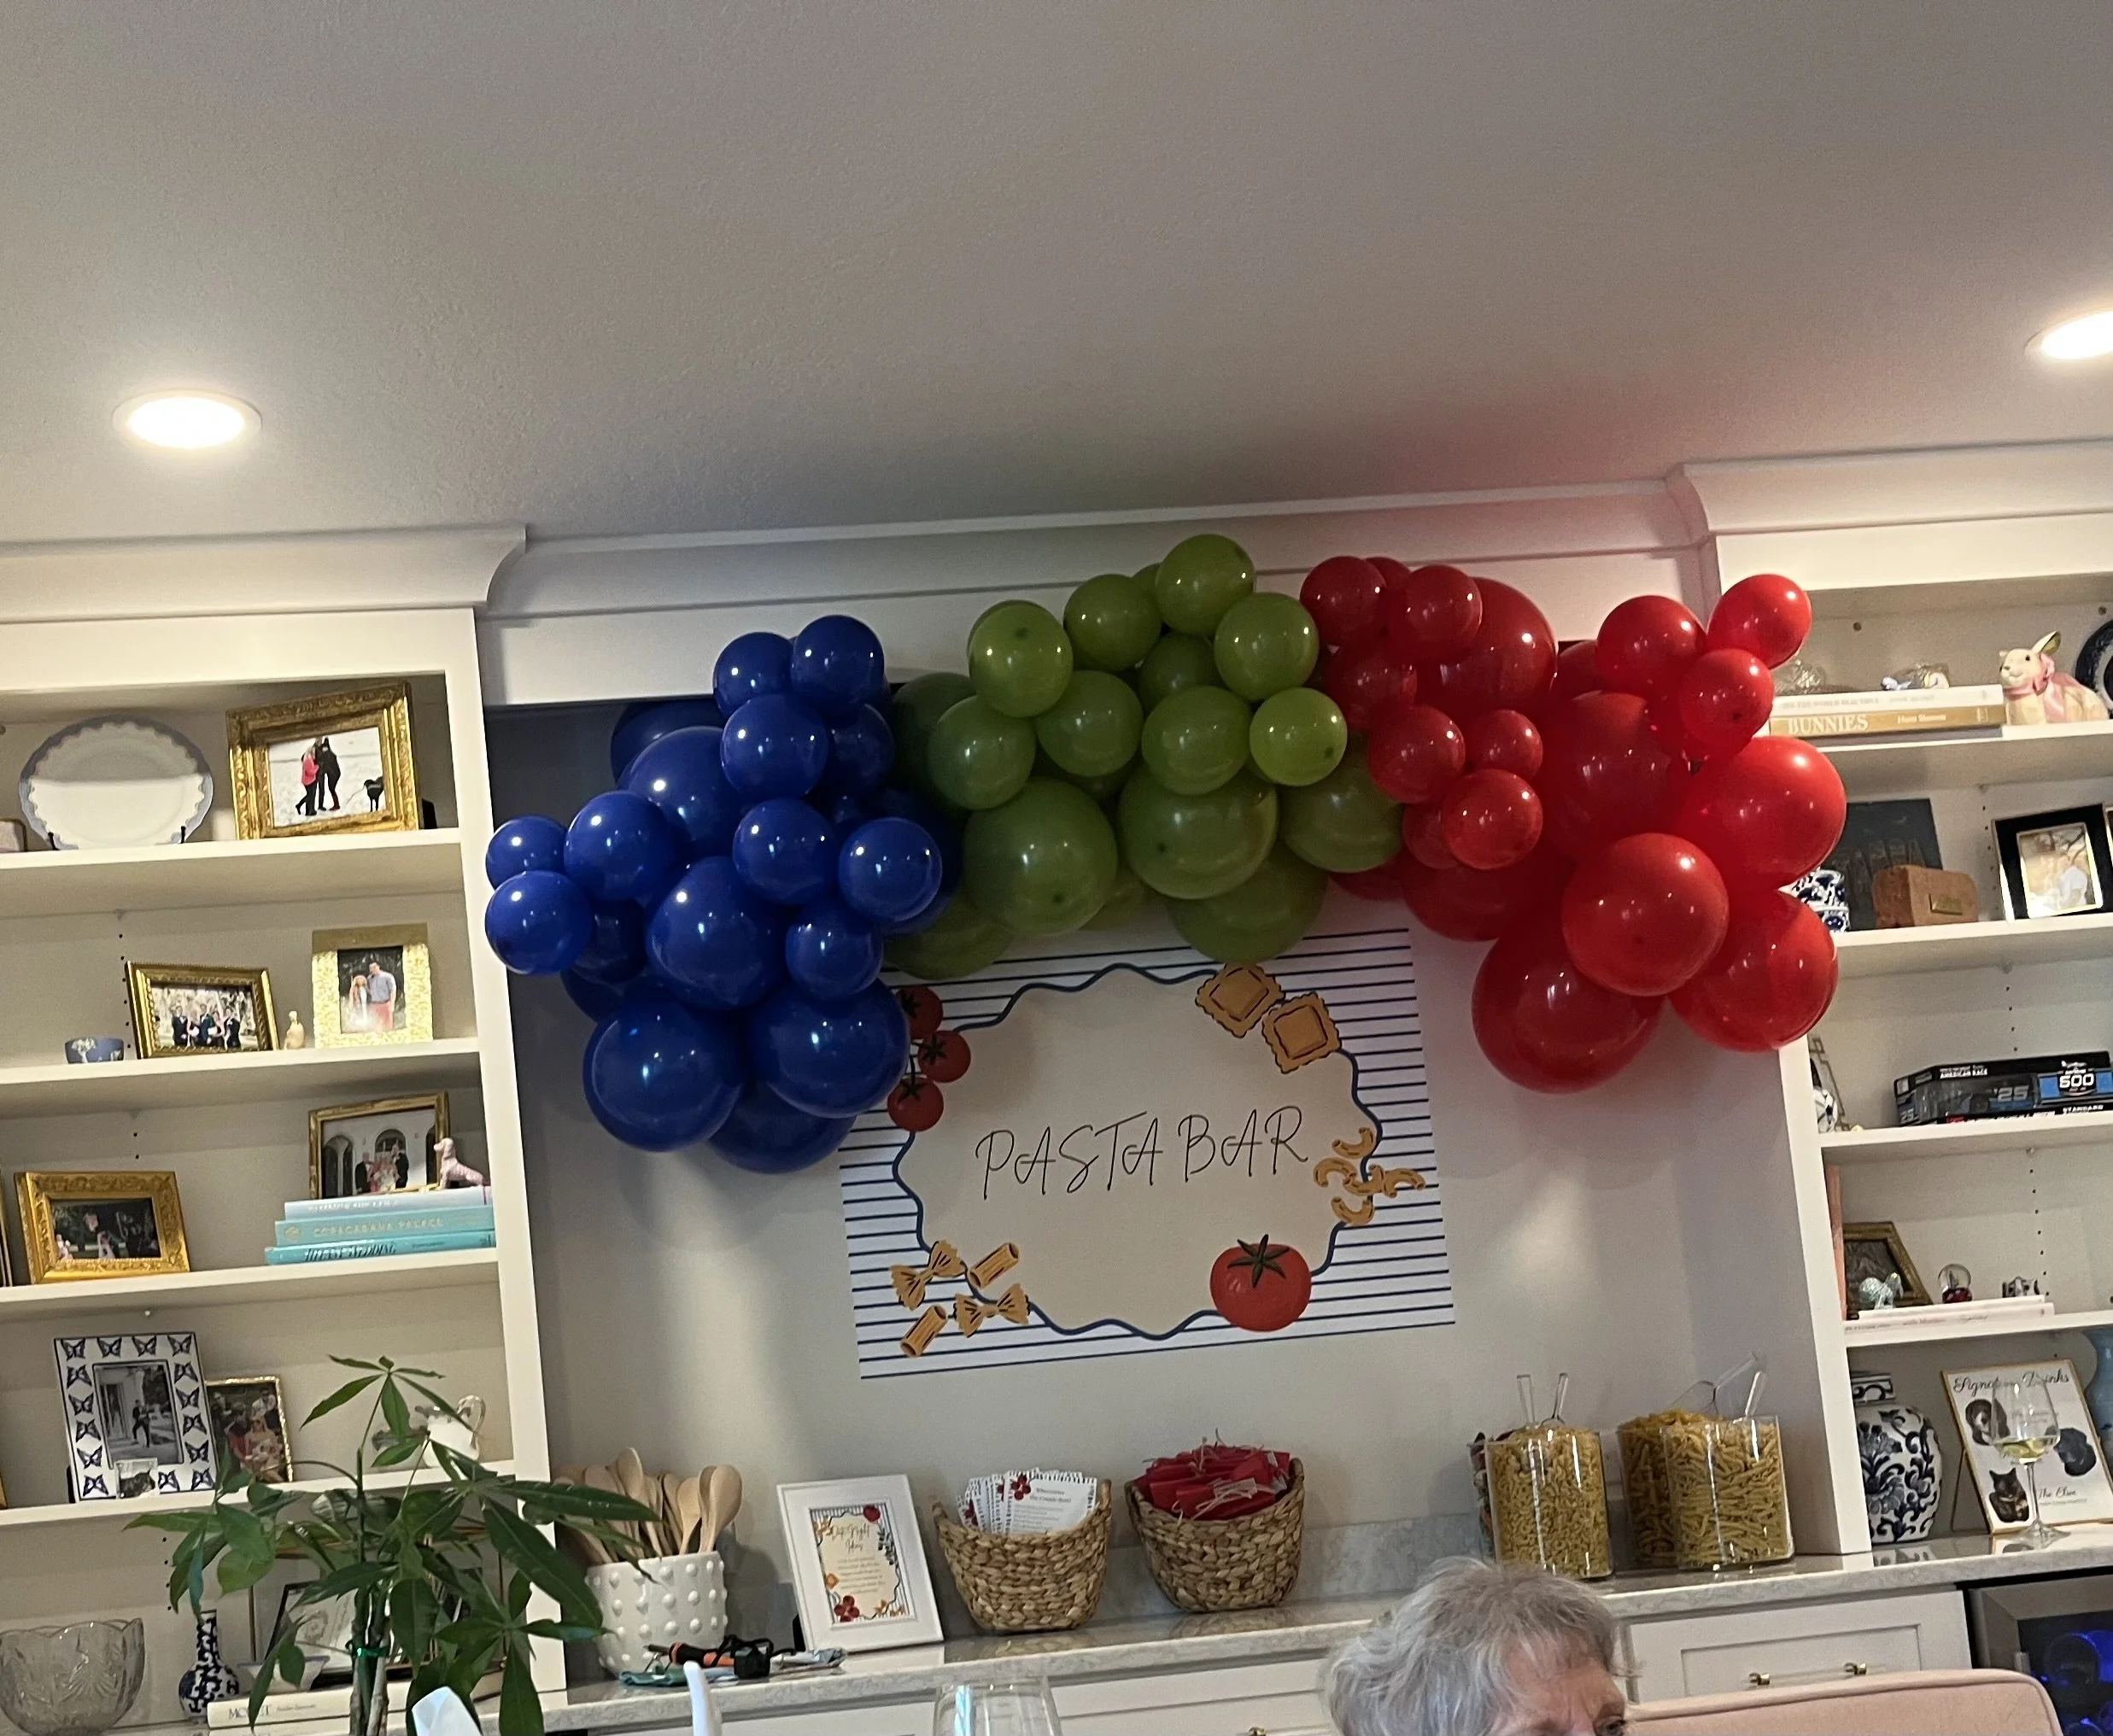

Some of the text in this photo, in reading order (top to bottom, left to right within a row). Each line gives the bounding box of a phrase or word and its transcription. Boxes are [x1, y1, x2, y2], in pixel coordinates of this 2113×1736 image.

[1787, 714, 1870, 734] BUNNIES
[975, 1105, 1308, 1200] PASTA BAR
